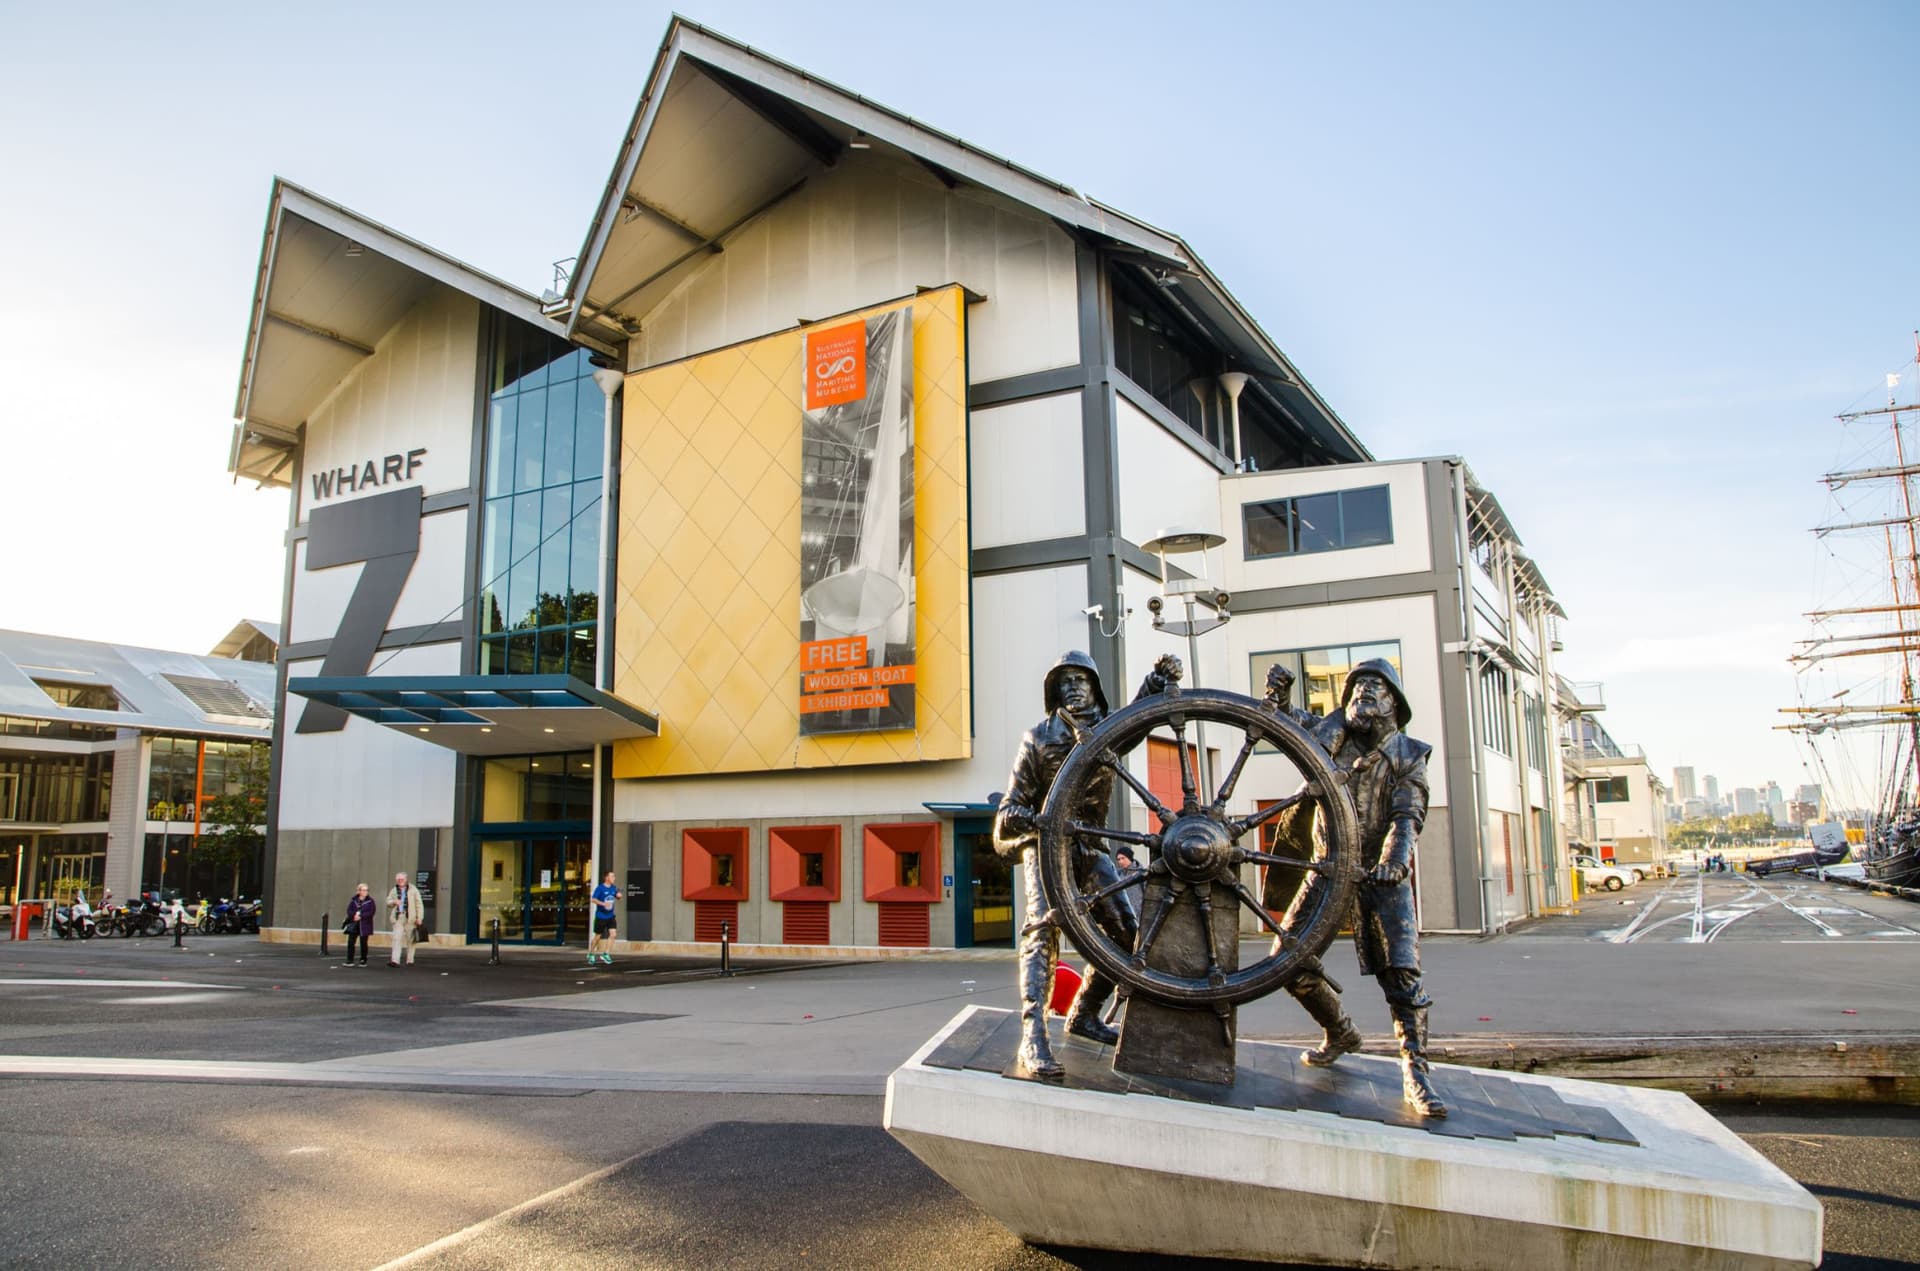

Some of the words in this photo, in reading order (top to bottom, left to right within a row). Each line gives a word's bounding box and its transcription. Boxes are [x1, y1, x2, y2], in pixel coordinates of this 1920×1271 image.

[816, 339, 856, 353] AUSTRALIAN
[816, 347, 856, 361] NATIONAL
[816, 375, 856, 388] MARITIME
[816, 383, 856, 397] MUSEUM
[312, 448, 427, 500] WHARF
[295, 485, 423, 734] 7
[808, 642, 862, 665] FREE
[809, 671, 868, 689] WOODEN
[873, 669, 907, 682] BOAT
[808, 692, 884, 709] EXHIBITION
